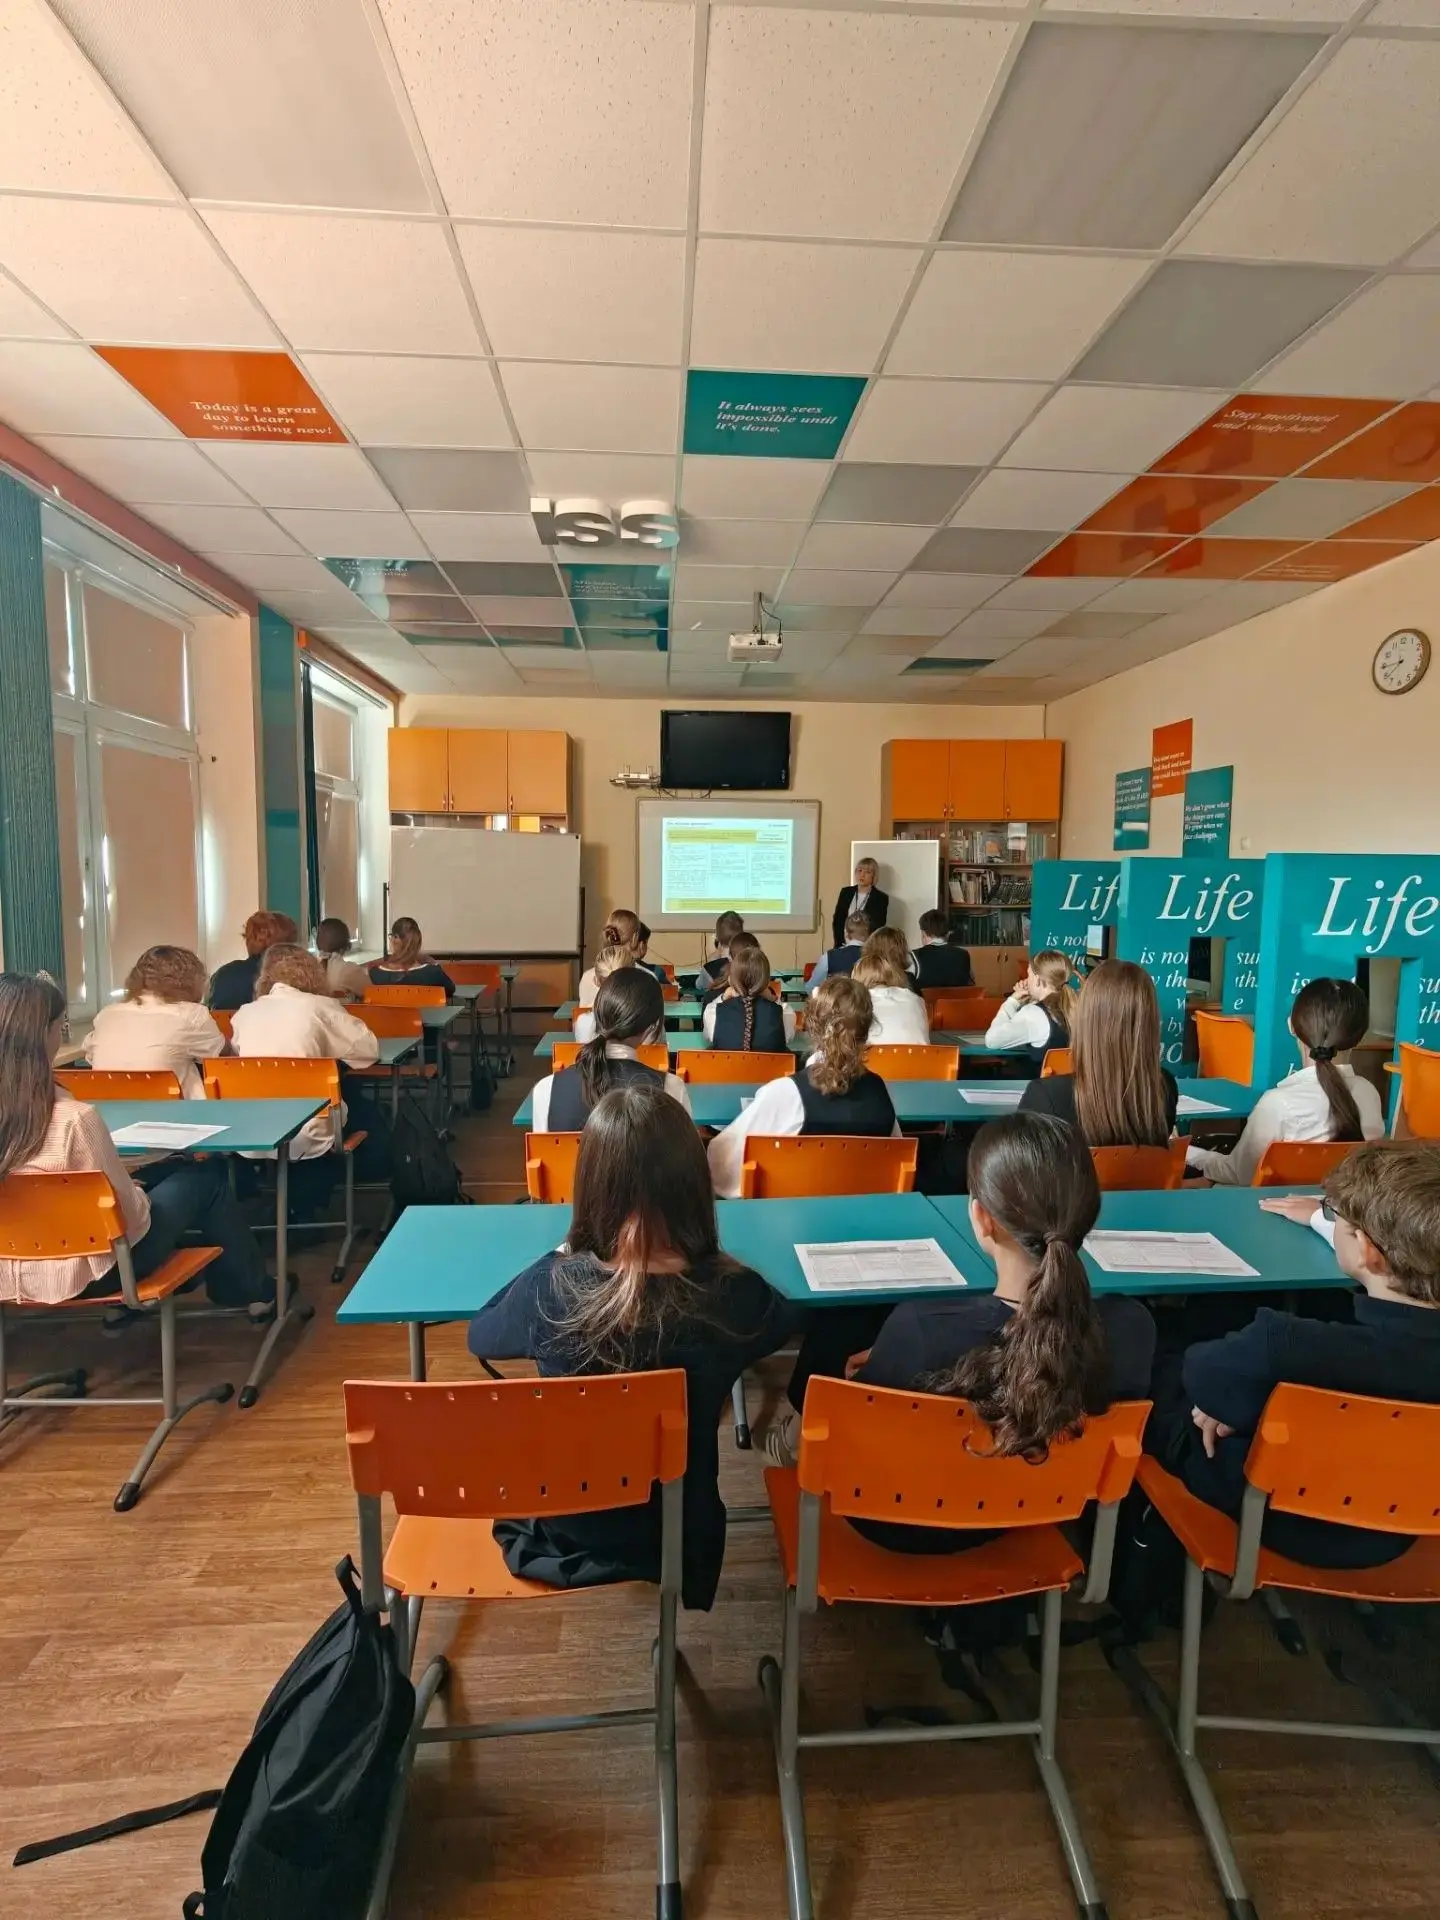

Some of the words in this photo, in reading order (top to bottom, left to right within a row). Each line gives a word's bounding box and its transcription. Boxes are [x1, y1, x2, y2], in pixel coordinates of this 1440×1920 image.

[191, 401, 239, 412] Today
[244, 403, 257, 412] is
[277, 406, 317, 415] great
[718, 401, 731, 410] It
[735, 402, 787, 414] always
[202, 413, 230, 422] day
[234, 415, 249, 423] to
[254, 415, 295, 424] learn
[717, 411, 797, 423] impossible
[800, 415, 838, 425] until
[1260, 412, 1340, 423] motivated
[212, 424, 292, 435] something
[296, 427, 332, 435] new!
[715, 422, 738, 431] it's
[741, 423, 780, 433] done.
[1212, 421, 1248, 431] and
[531, 498, 680, 550] ISS
[1059, 873, 1121, 922] Lif
[1156, 873, 1254, 933] Life
[1311, 874, 1440, 954] Life
[1046, 932, 1059, 947] is
[1140, 947, 1155, 965] is
